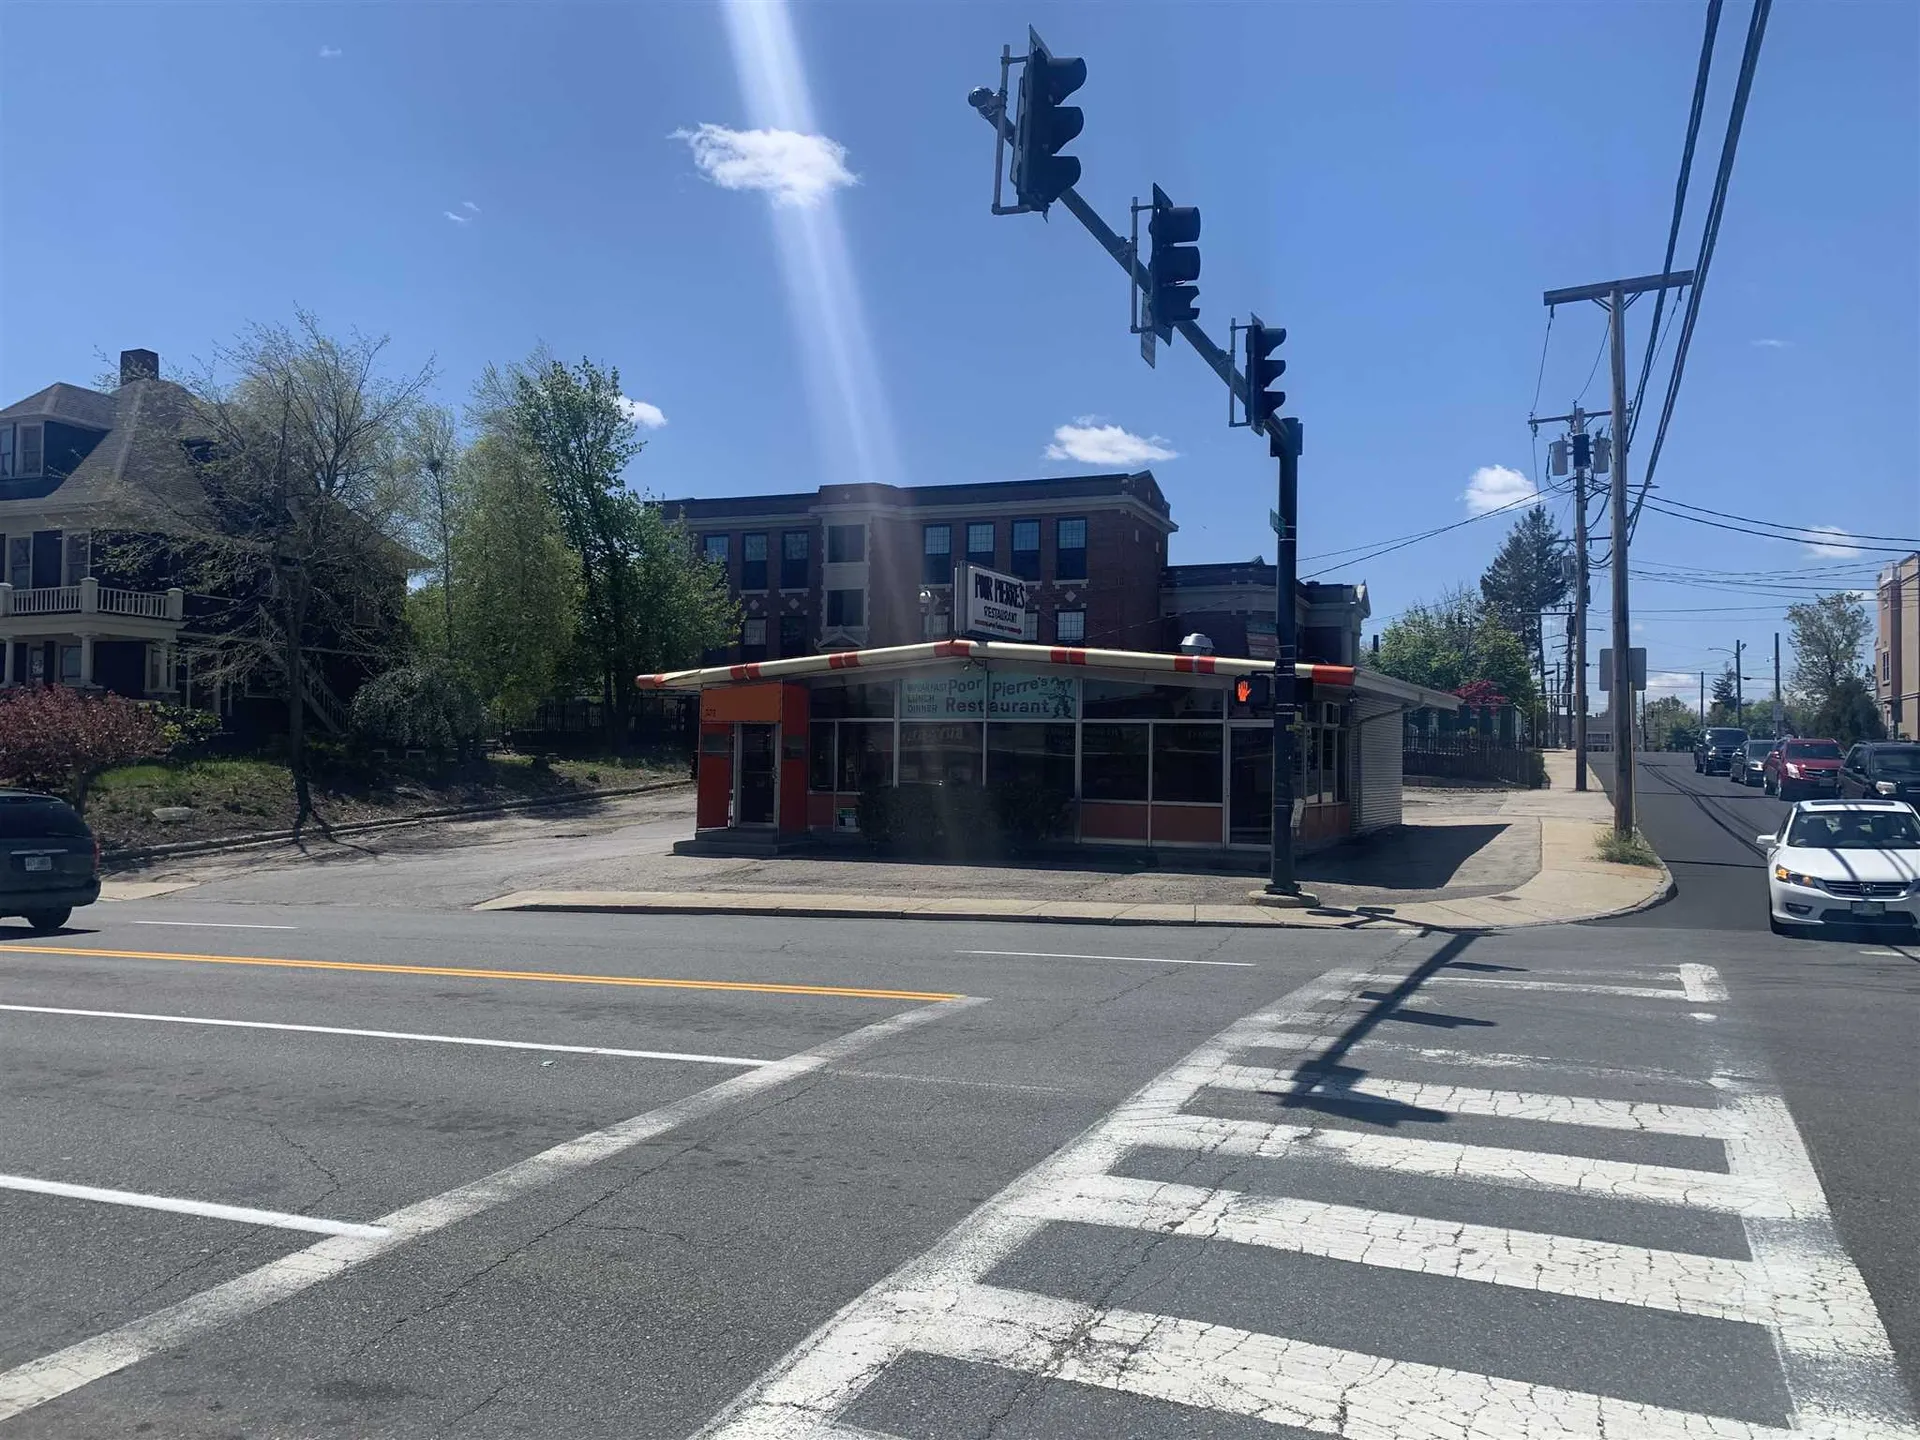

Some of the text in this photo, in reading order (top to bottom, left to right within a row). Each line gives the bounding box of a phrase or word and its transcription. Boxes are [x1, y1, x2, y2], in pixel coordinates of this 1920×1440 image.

[983, 605, 1018, 624] RESTAURANT
[949, 676, 1048, 700] Poor Pierre's
[907, 703, 938, 713] DINNER
[945, 696, 1049, 714] Restaurant
